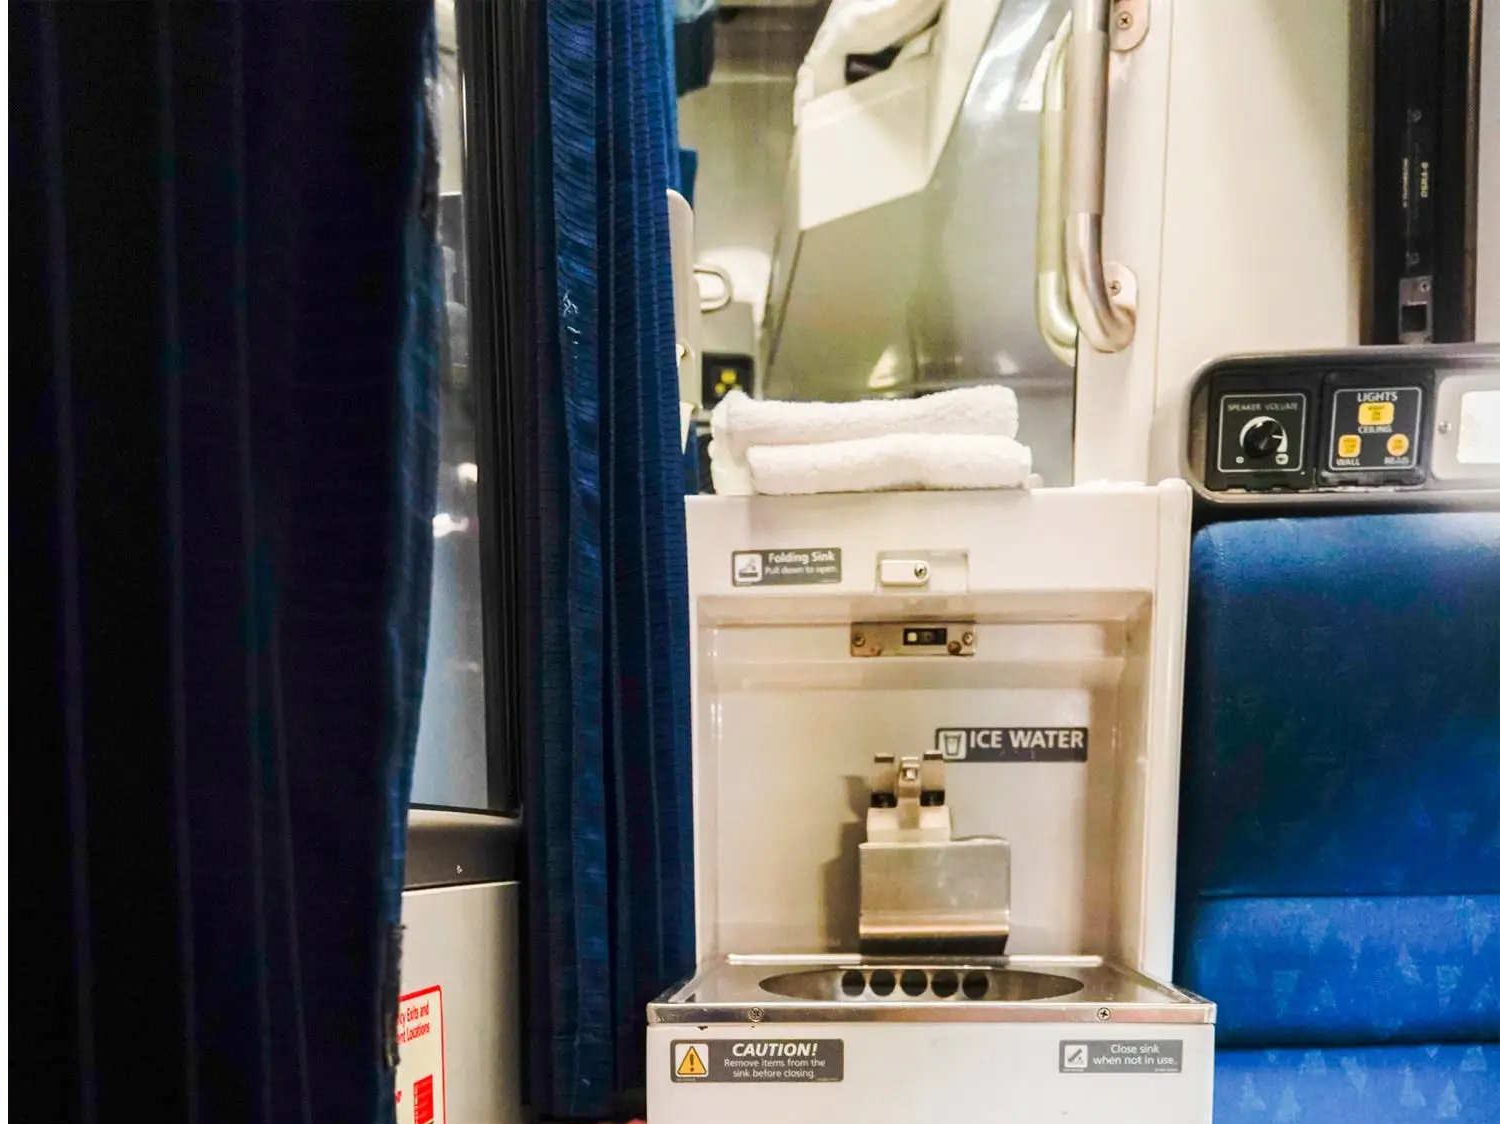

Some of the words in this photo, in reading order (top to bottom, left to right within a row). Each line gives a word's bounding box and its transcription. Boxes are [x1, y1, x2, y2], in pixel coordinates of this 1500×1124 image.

[1357, 392, 1398, 401] LIGHTS
[1227, 403, 1261, 411] SPEAKER
[1265, 402, 1298, 410] VOLUME
[1358, 425, 1392, 433] CEILING
[1336, 458, 1360, 466] WALL
[768, 552, 809, 564] Folding
[811, 550, 835, 562] Sink
[969, 730, 1003, 748] ICE
[1008, 730, 1084, 748] WATER
[732, 1043, 818, 1057] CAUTION!
[1110, 1044, 1137, 1054] Close
[1140, 1044, 1159, 1053] sink
[724, 1058, 759, 1067] Remove
[761, 1058, 785, 1067] items
[787, 1058, 808, 1067] from
[810, 1058, 826, 1067] the
[1092, 1056, 1121, 1065] when
[1124, 1056, 1141, 1065] not
[1144, 1055, 1154, 1065] in
[1156, 1056, 1178, 1065] use.
[732, 1069, 750, 1077] sink
[752, 1068, 781, 1078] before
[783, 1069, 816, 1080] closing.
